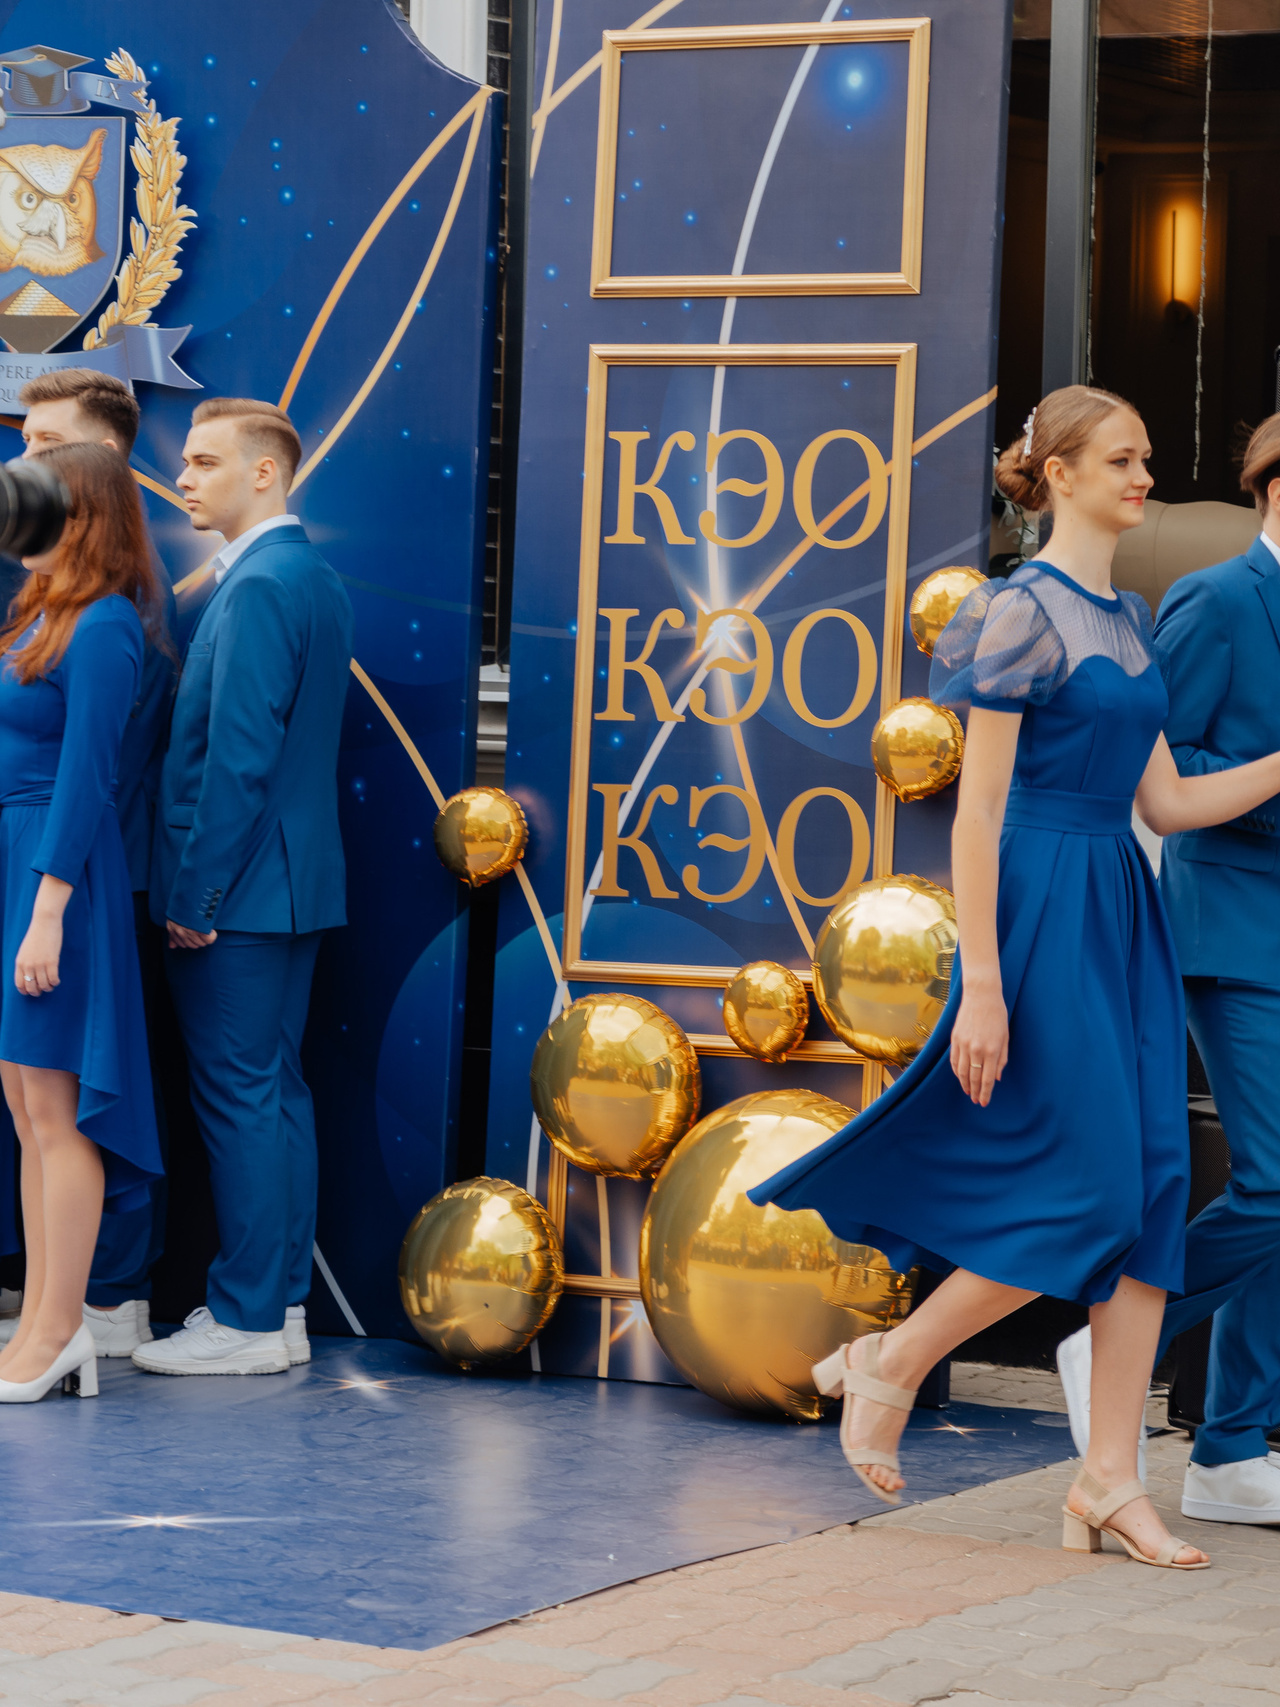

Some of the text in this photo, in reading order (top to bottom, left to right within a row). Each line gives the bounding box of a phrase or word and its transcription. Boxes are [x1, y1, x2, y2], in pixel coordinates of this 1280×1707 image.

[95, 79, 123, 100] IX
[603, 429, 889, 550] КЭО
[594, 608, 878, 729] КЭО
[589, 783, 871, 907] КЭО
